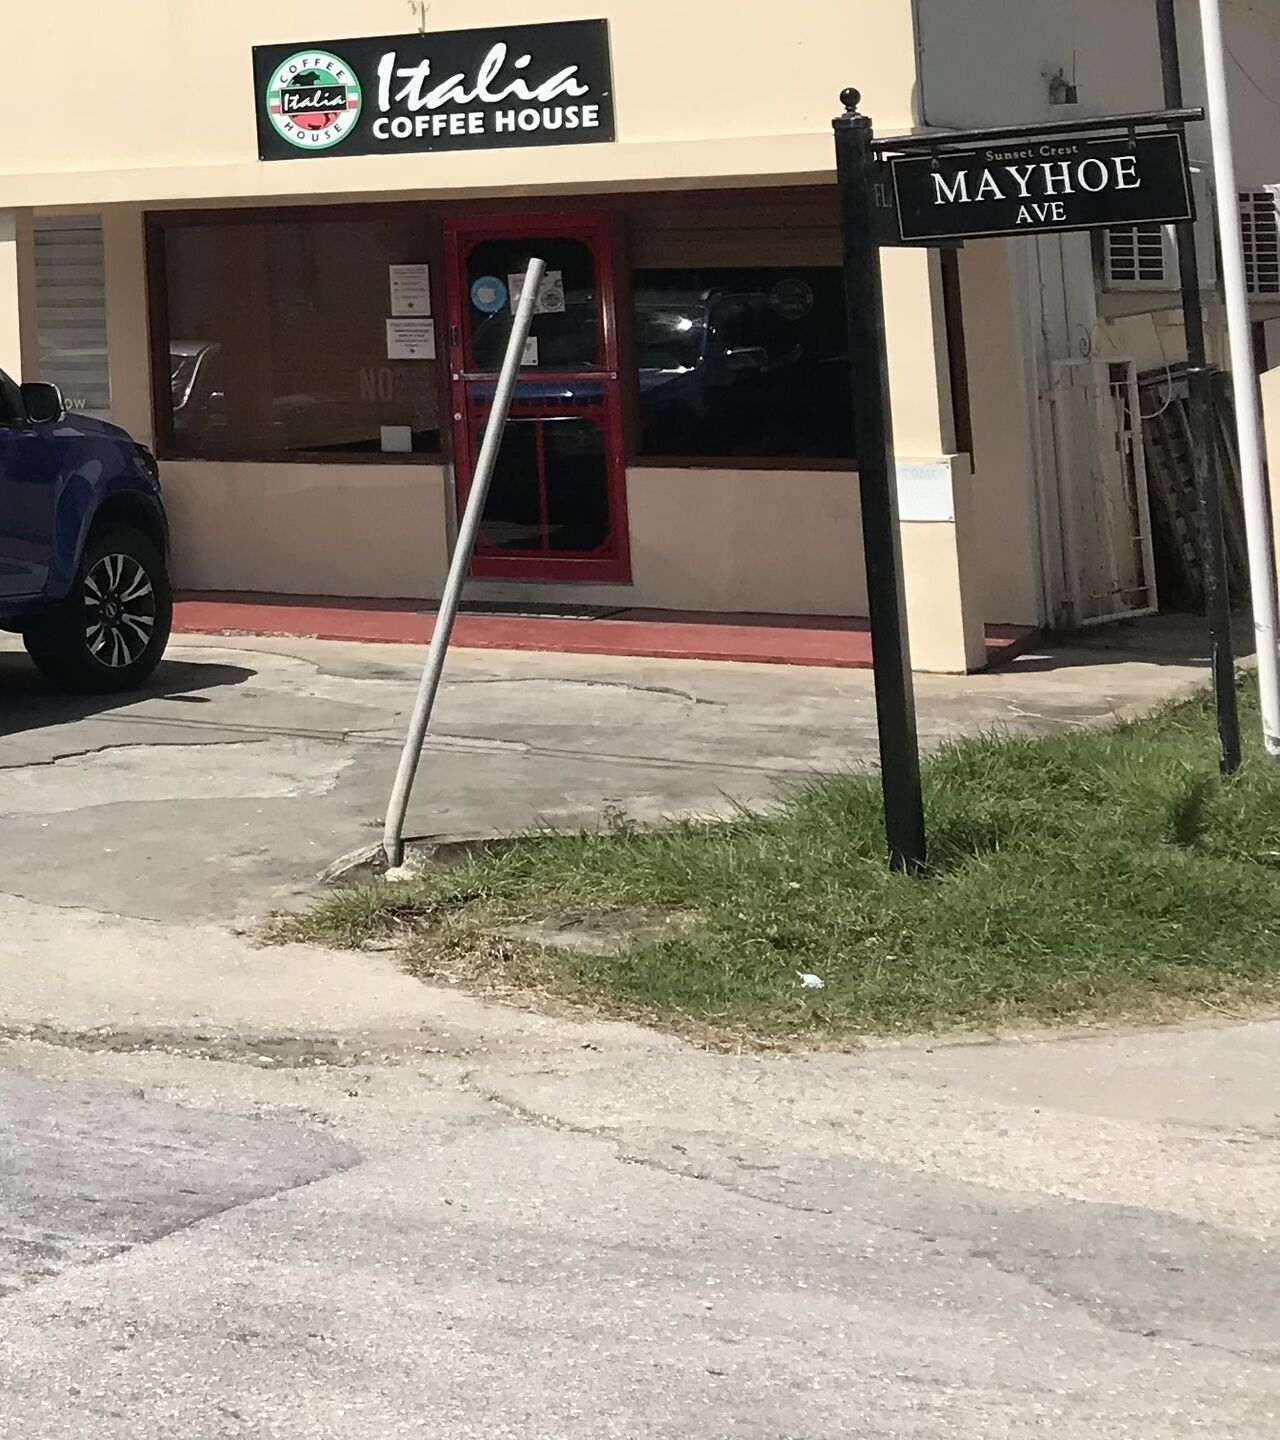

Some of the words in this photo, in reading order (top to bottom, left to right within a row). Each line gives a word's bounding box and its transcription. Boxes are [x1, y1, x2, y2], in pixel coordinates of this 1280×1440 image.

[279, 58, 347, 85] COFFEE
[376, 41, 590, 113] Italia
[283, 89, 346, 112] Italia
[284, 122, 343, 143] HOUSE
[372, 112, 485, 140] COFFEE
[496, 105, 599, 134] HOUSE
[985, 147, 1034, 162] Sunset
[1040, 144, 1079, 157] Crest
[930, 155, 1141, 205] MAYHOE
[1015, 202, 1067, 224] AVE
